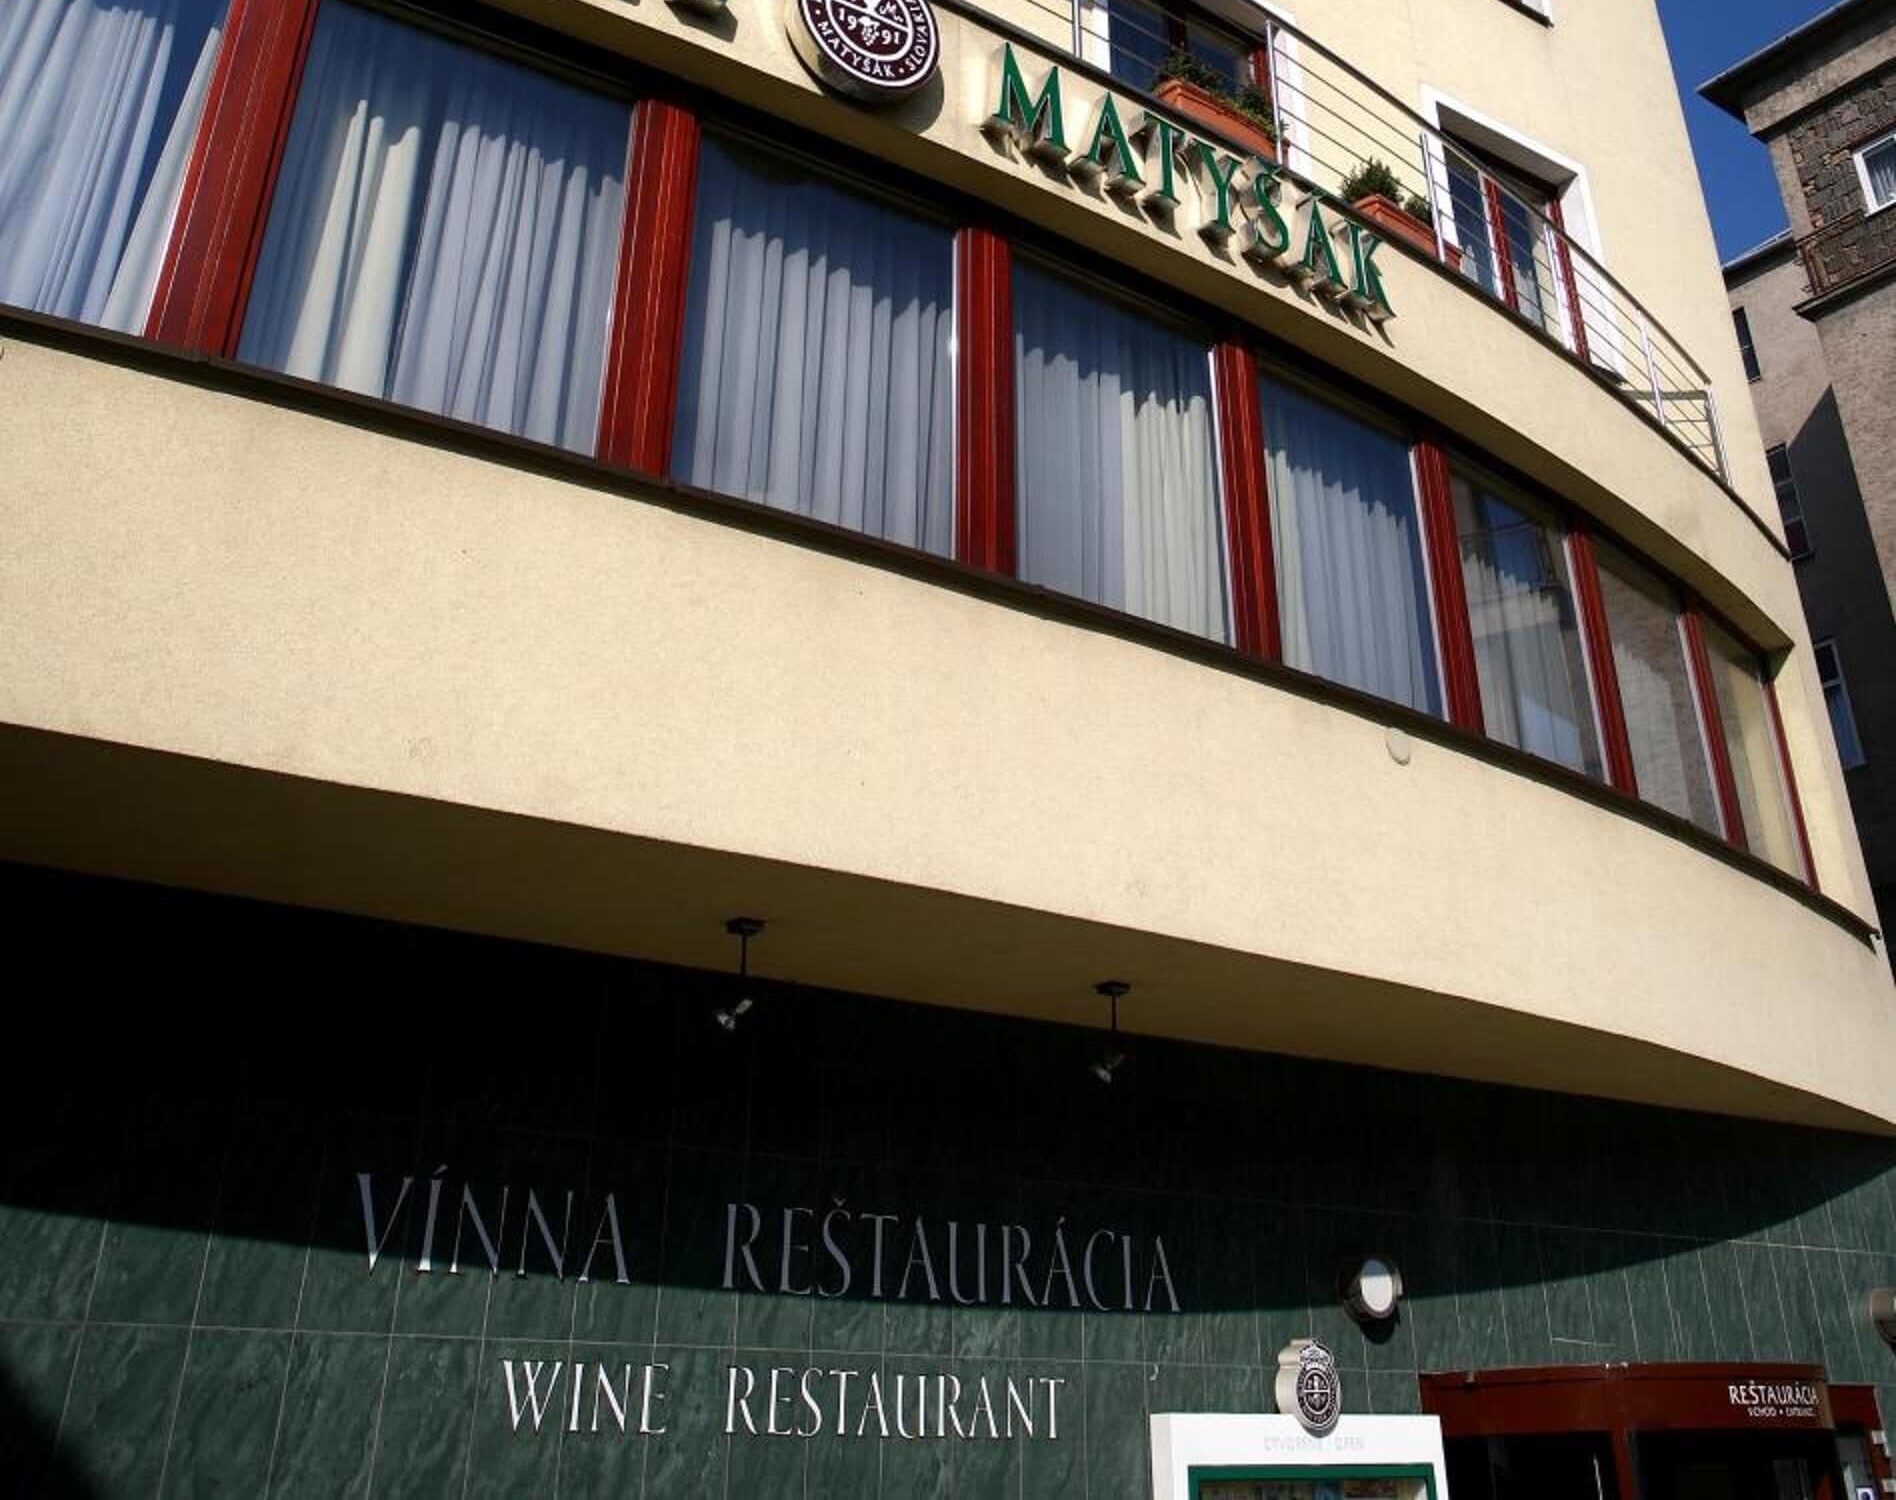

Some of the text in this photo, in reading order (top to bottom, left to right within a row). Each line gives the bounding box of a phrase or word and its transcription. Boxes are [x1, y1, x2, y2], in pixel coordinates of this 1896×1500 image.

[982, 41, 1396, 318] MATYŠÁK
[357, 1164, 1182, 1312] VÍNNA REŠTAURÁCIA
[503, 1360, 1065, 1438] WINE RESTAURANT
